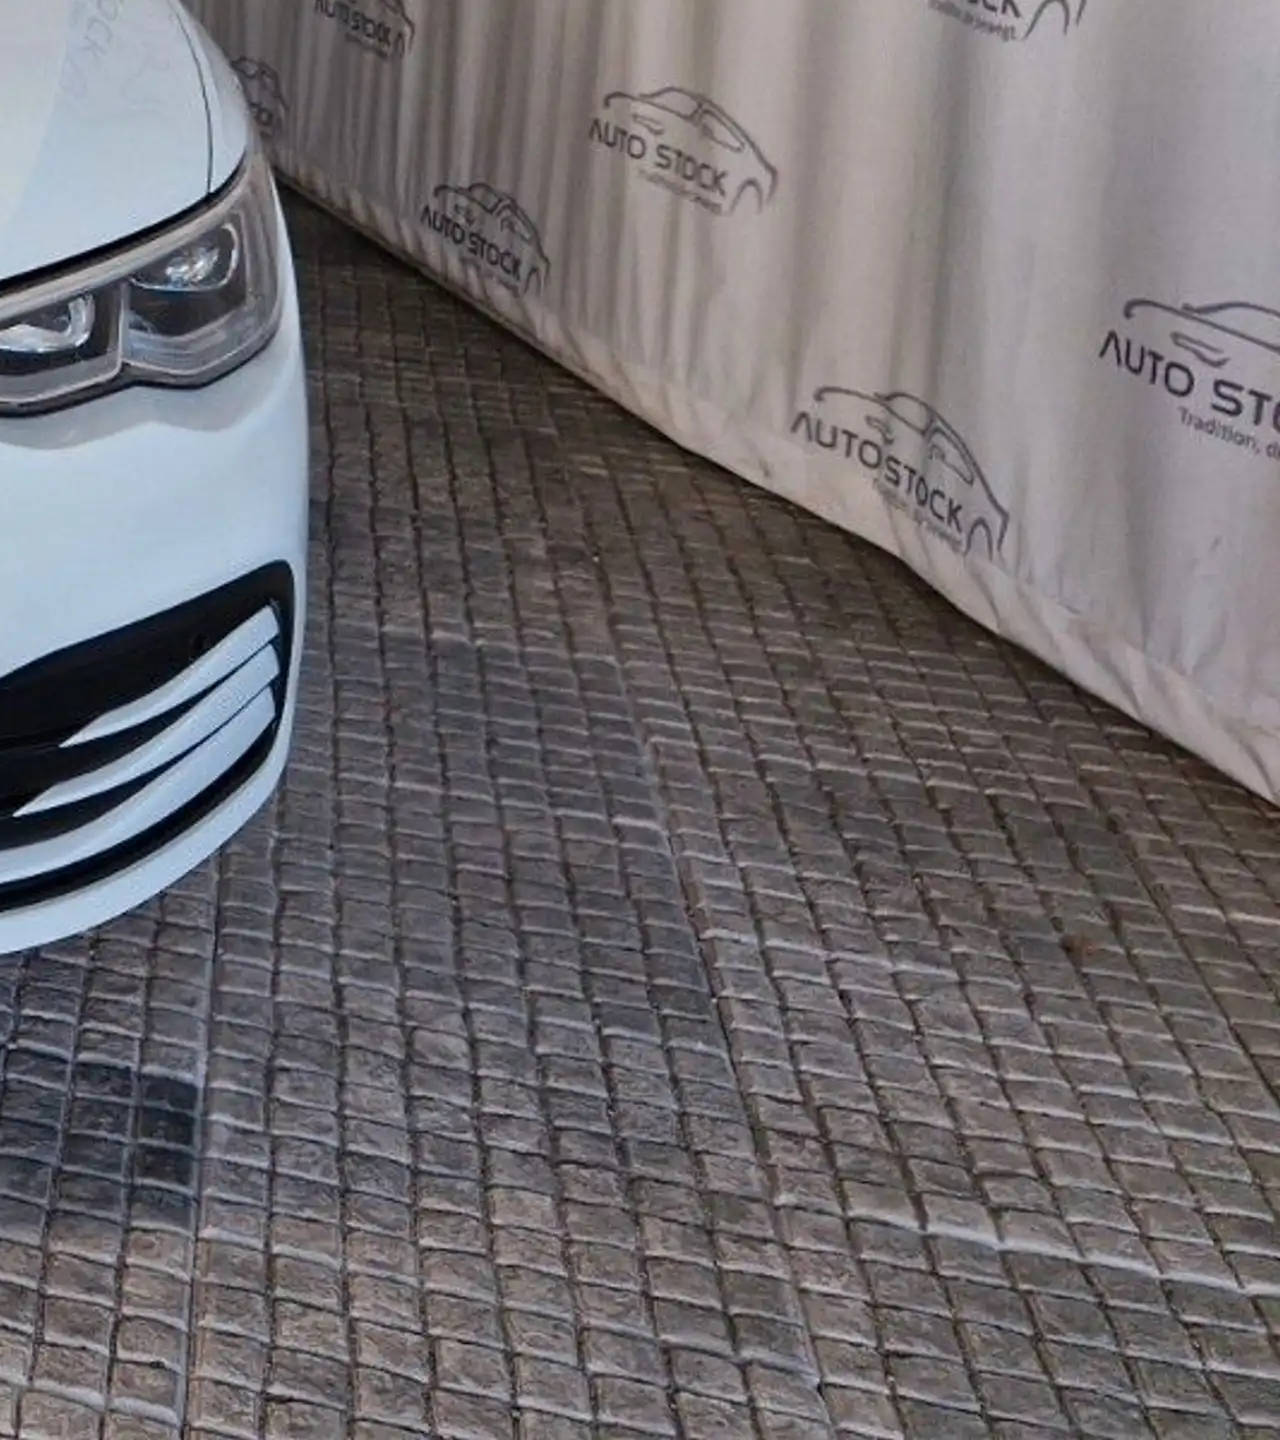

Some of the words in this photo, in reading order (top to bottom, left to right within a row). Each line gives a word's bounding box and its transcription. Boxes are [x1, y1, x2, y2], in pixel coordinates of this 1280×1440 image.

[589, 117, 646, 160] AUTO
[653, 143, 730, 198] STOCK
[419, 204, 465, 244] AUTO
[467, 232, 521, 281] STOCK
[1098, 329, 1195, 398] AUTO
[791, 411, 883, 469] AUTO
[883, 456, 963, 534] STOCK
